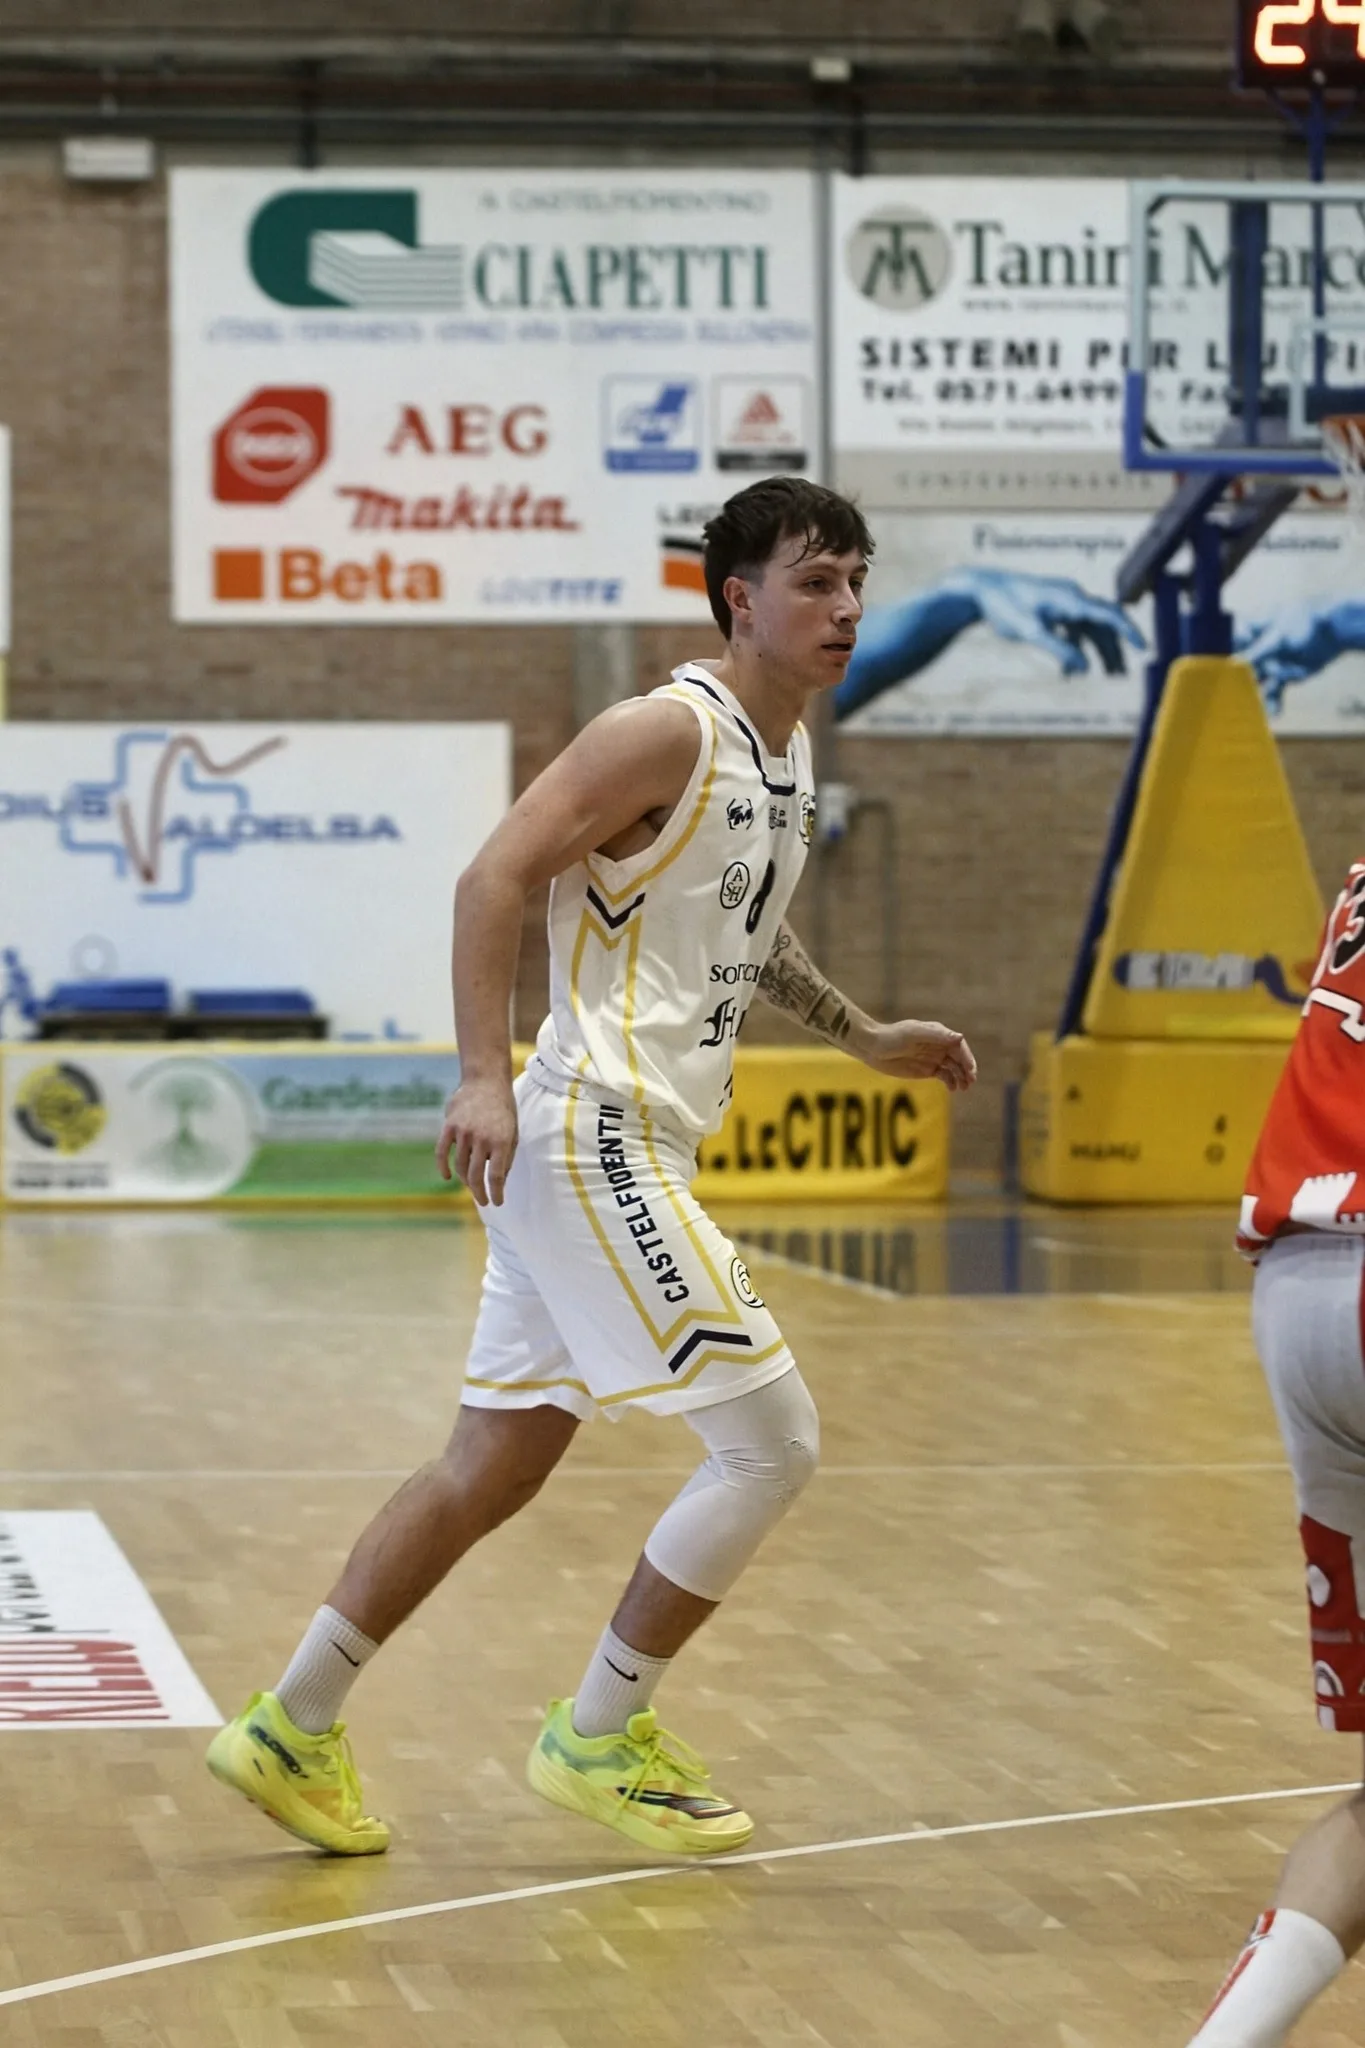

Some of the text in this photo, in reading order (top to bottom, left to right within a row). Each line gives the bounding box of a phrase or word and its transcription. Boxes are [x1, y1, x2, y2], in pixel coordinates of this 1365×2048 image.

[473, 243, 770, 309] CIAPETTI
[1183, 222, 1365, 290] Marc
[861, 337, 1060, 369] SISTEMI
[386, 403, 550, 457] AEG
[278, 547, 444, 603] Beta
